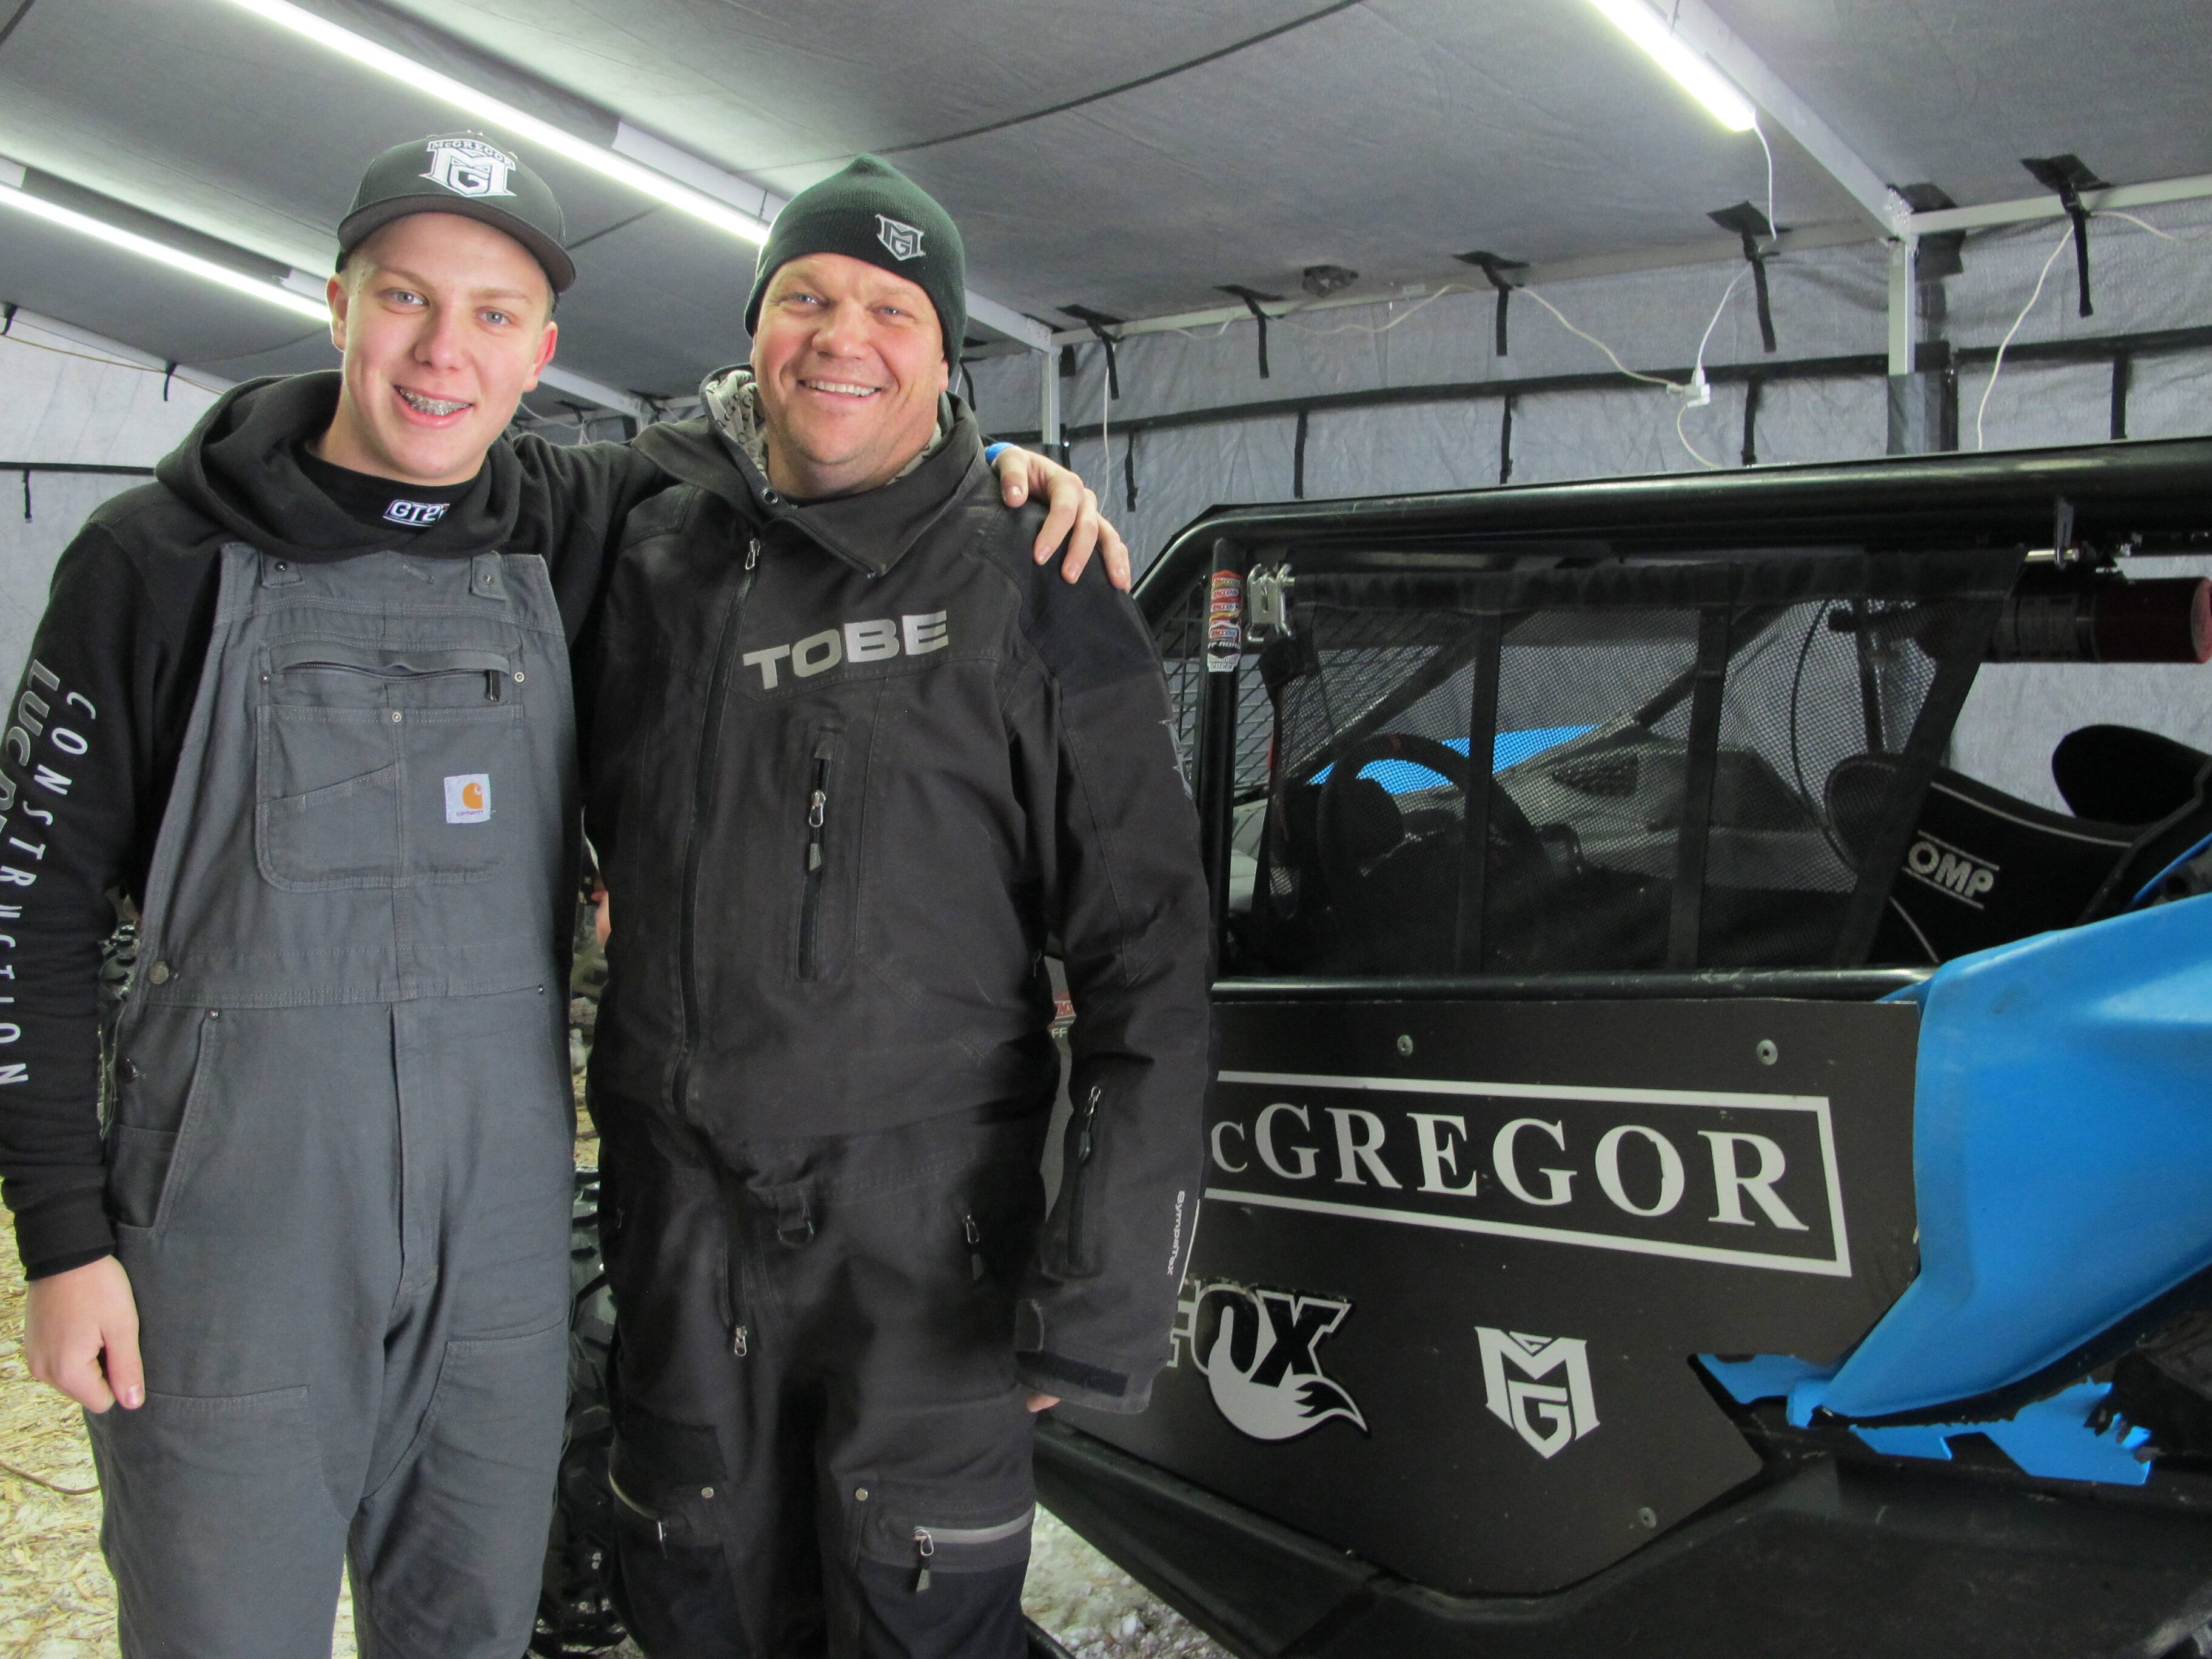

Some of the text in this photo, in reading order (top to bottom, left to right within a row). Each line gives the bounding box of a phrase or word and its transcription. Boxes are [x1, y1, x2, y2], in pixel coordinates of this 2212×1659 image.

[431, 140, 514, 167] McGREGOR
[743, 610, 949, 690] TOBE
[1908, 841, 1994, 897] OMP
[1211, 1102, 1809, 1232] cGREGOR
